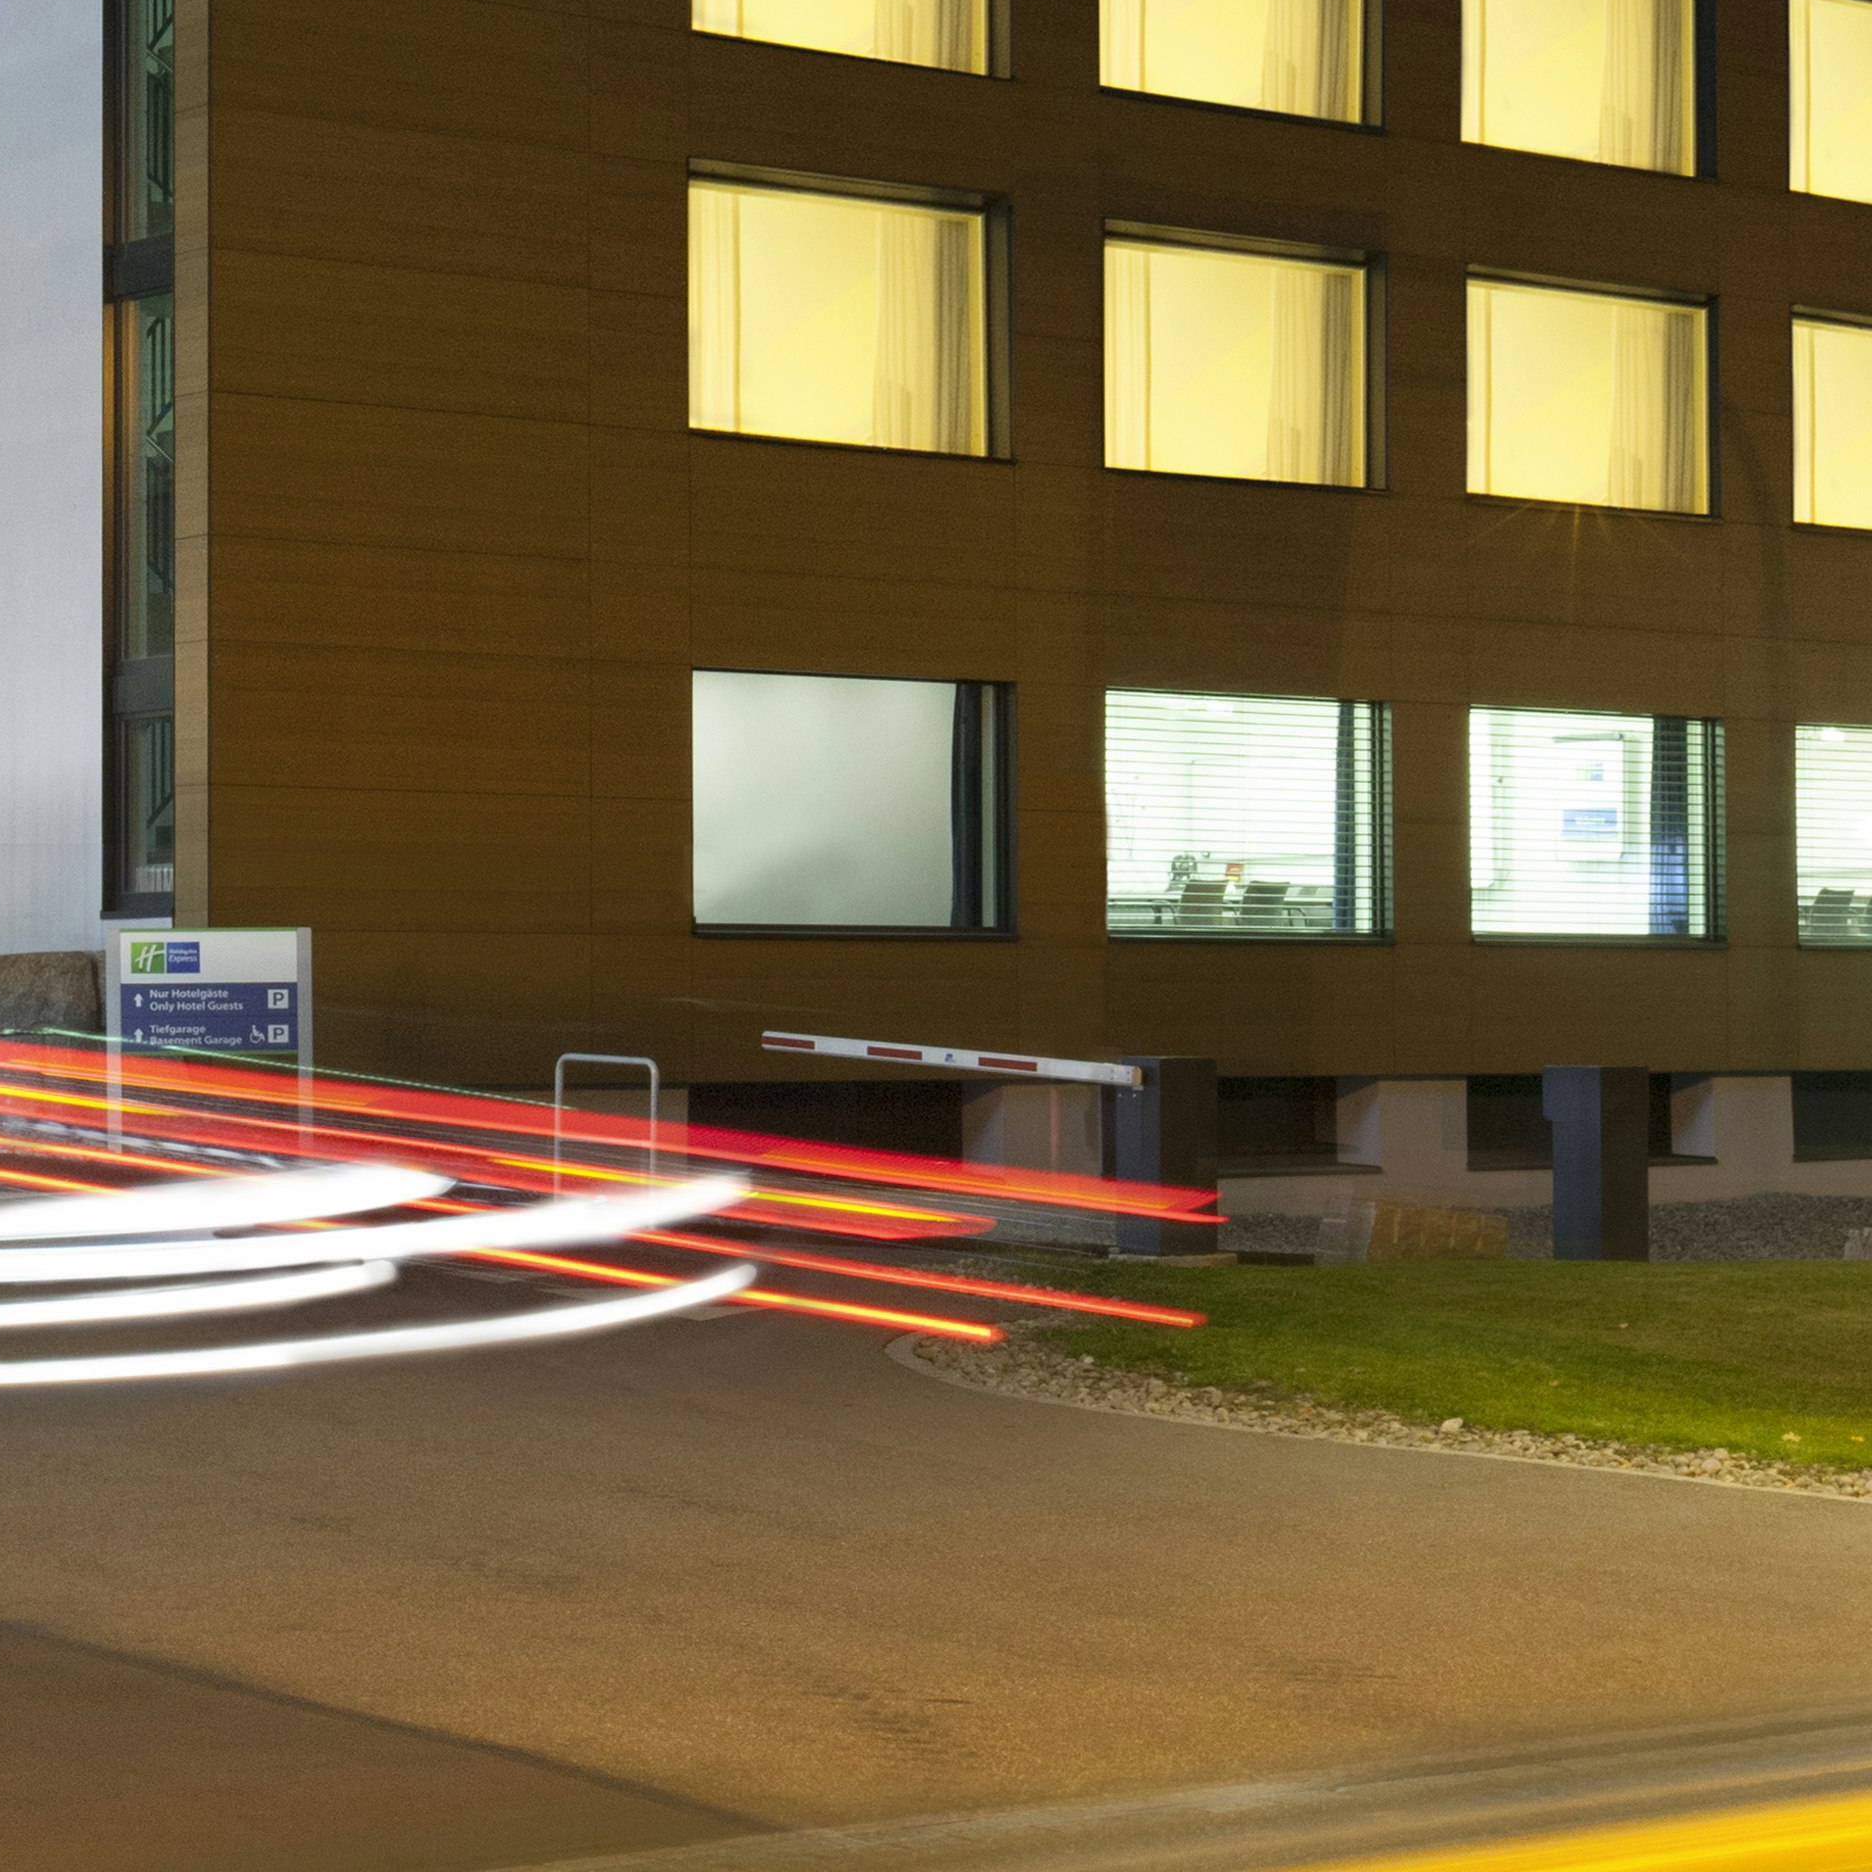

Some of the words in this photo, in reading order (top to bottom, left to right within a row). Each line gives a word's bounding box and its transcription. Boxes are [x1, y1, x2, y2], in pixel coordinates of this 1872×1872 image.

[149, 989, 169, 999] Nur
[171, 988, 229, 1000] Hotelgäste
[273, 992, 285, 1006] P
[149, 1001, 175, 1013] Only
[177, 1001, 205, 1011] Hotel
[207, 1001, 244, 1011] Guests
[149, 1024, 206, 1035] Tiefgarage
[273, 1027, 285, 1040] P
[149, 1036, 202, 1045] Basement
[204, 1035, 242, 1046] Garage
